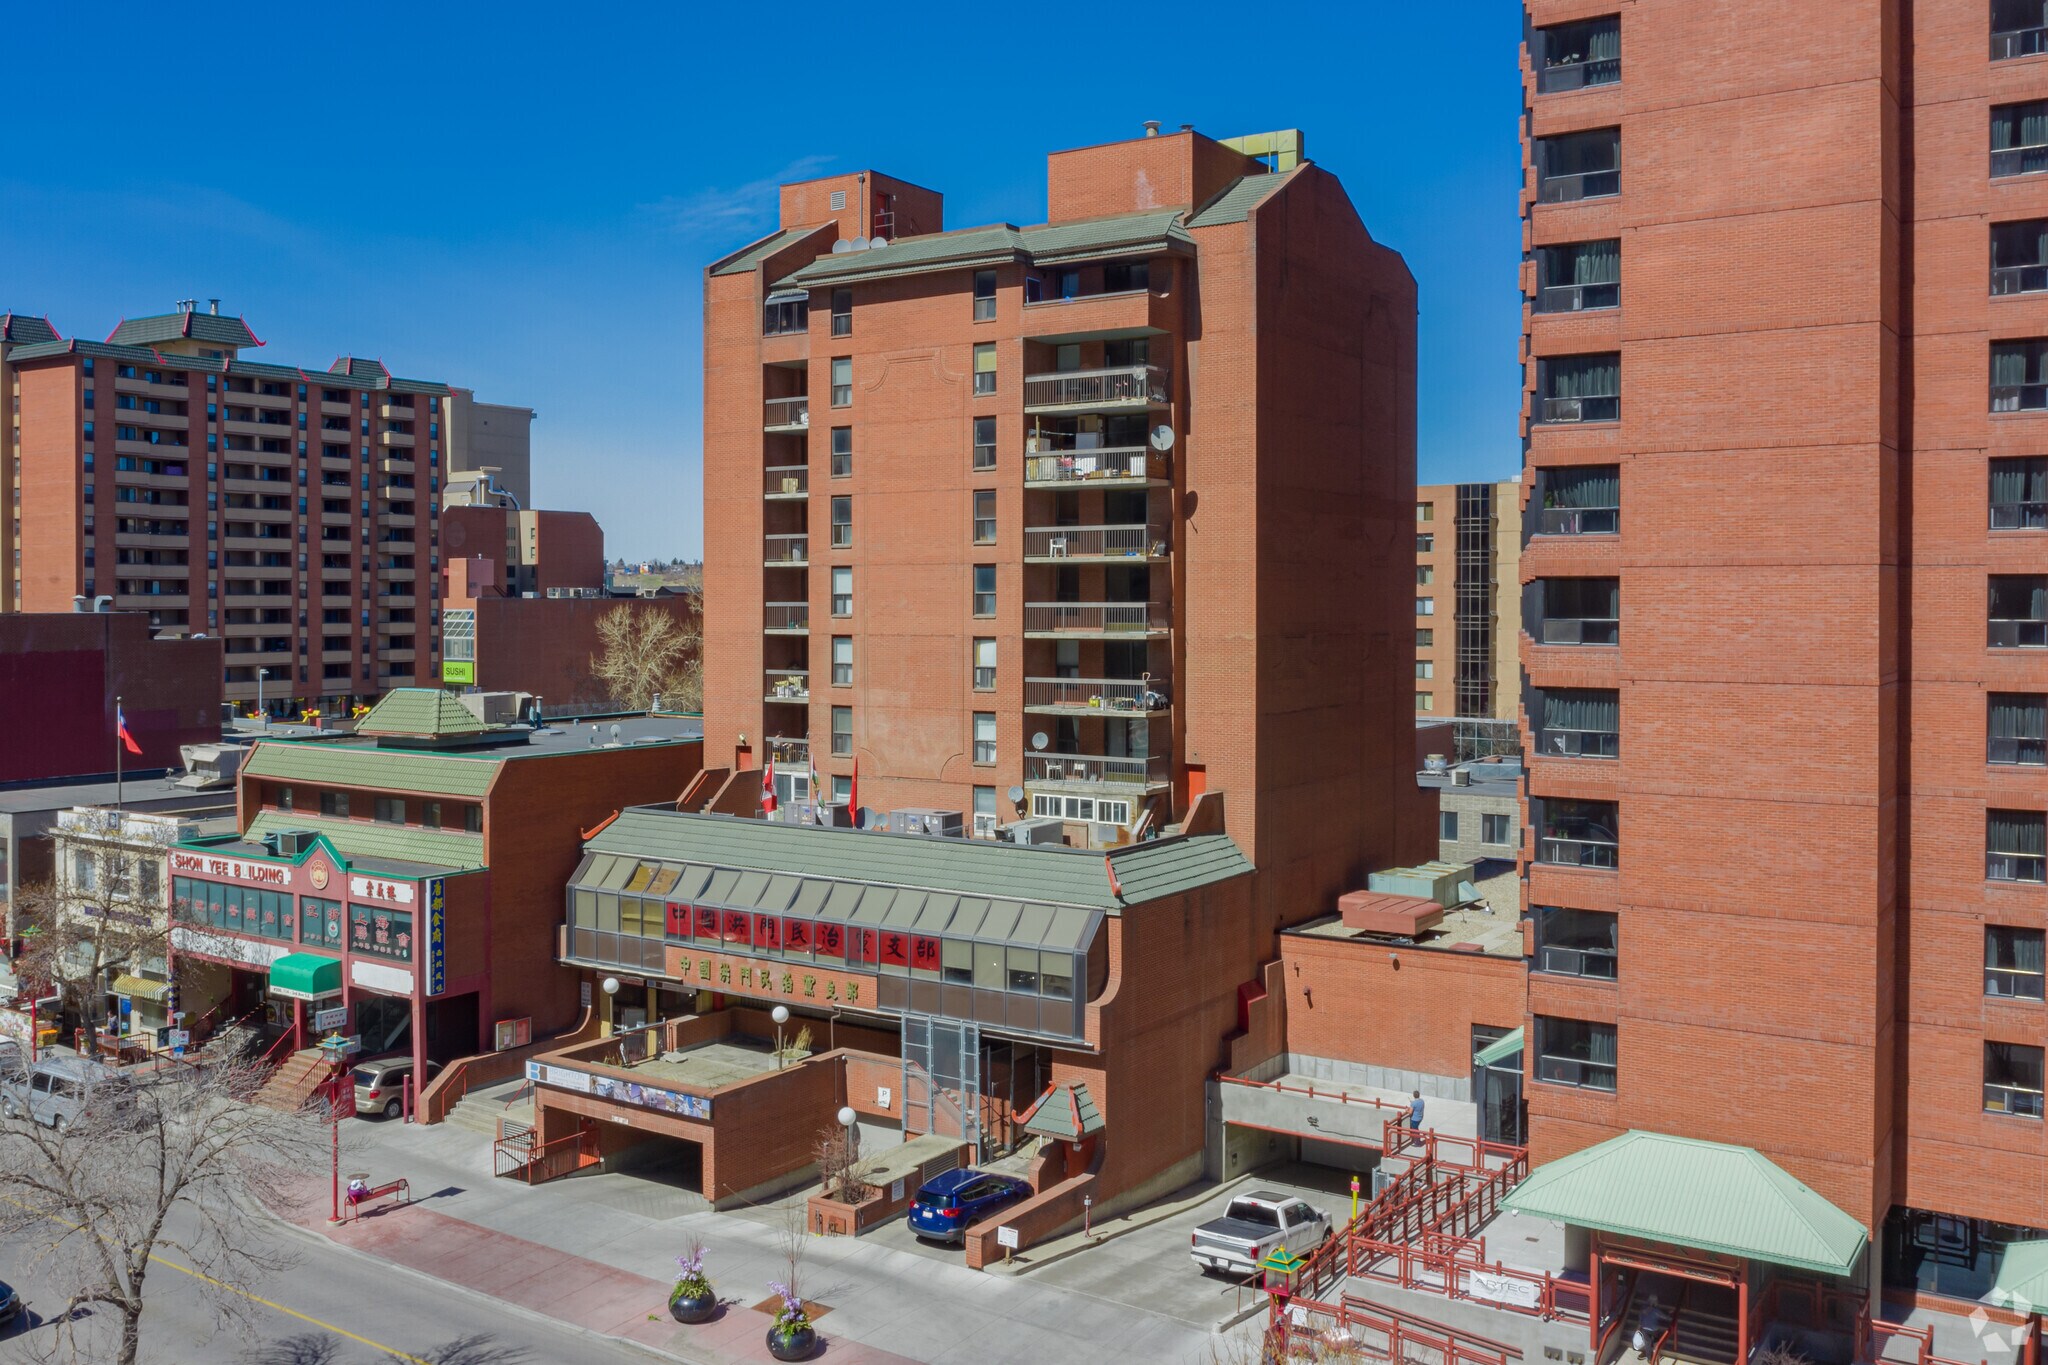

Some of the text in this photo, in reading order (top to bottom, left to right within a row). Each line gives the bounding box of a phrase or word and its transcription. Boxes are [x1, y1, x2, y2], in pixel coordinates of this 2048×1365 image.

[445, 667, 466, 677] SUSHI
[175, 854, 203, 871] SHON
[209, 859, 228, 876] YEE
[672, 907, 936, 962] 中國洪門民治黨支部
[549, 1067, 585, 1081] BRIGHTON
